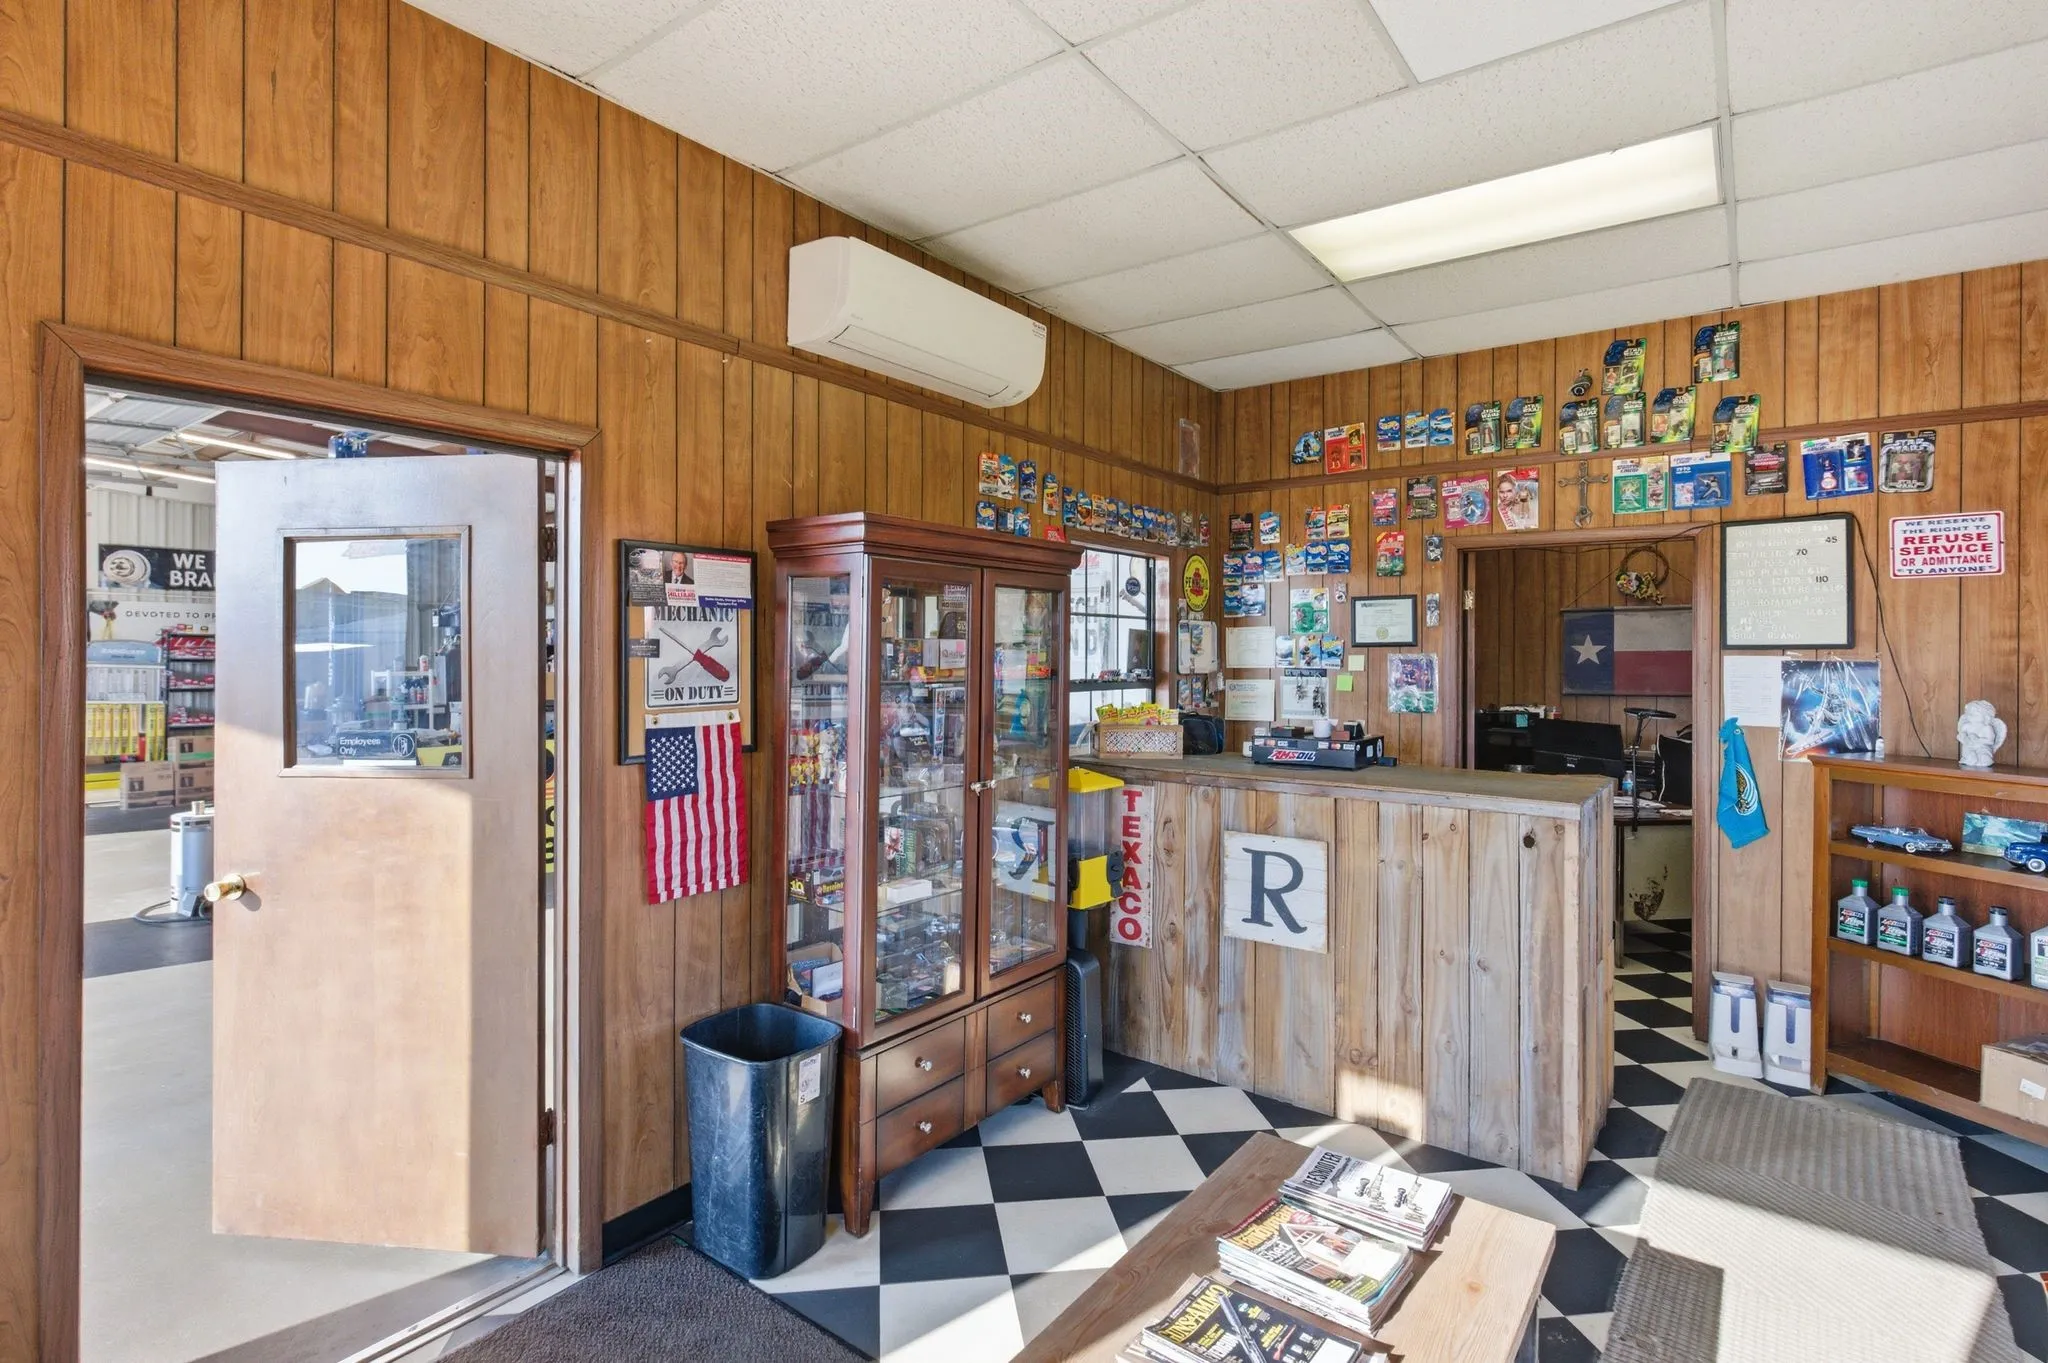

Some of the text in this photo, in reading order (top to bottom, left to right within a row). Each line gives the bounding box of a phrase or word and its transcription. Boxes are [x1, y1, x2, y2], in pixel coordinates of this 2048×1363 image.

[1928, 517, 1985, 525] RESERVE
[1825, 536, 1838, 544] 45
[1904, 532, 1988, 545] REFUSE
[1900, 543, 1993, 556] SERVICE
[173, 553, 206, 569] WE
[1901, 554, 1992, 567] OR ADMITTANCE
[1929, 566, 1985, 574] ANYONE
[170, 570, 215, 587] BRA
[1816, 575, 1829, 583] 110
[126, 610, 180, 618] DEVOTED
[653, 605, 734, 622] MECHANIC
[665, 685, 723, 701] ON DUTY
[340, 737, 380, 745] Employees
[340, 747, 357, 756] Only
[1271, 749, 1315, 760] AMSOIL
[1117, 789, 1142, 941] TEXACO
[1241, 847, 1308, 935] R
